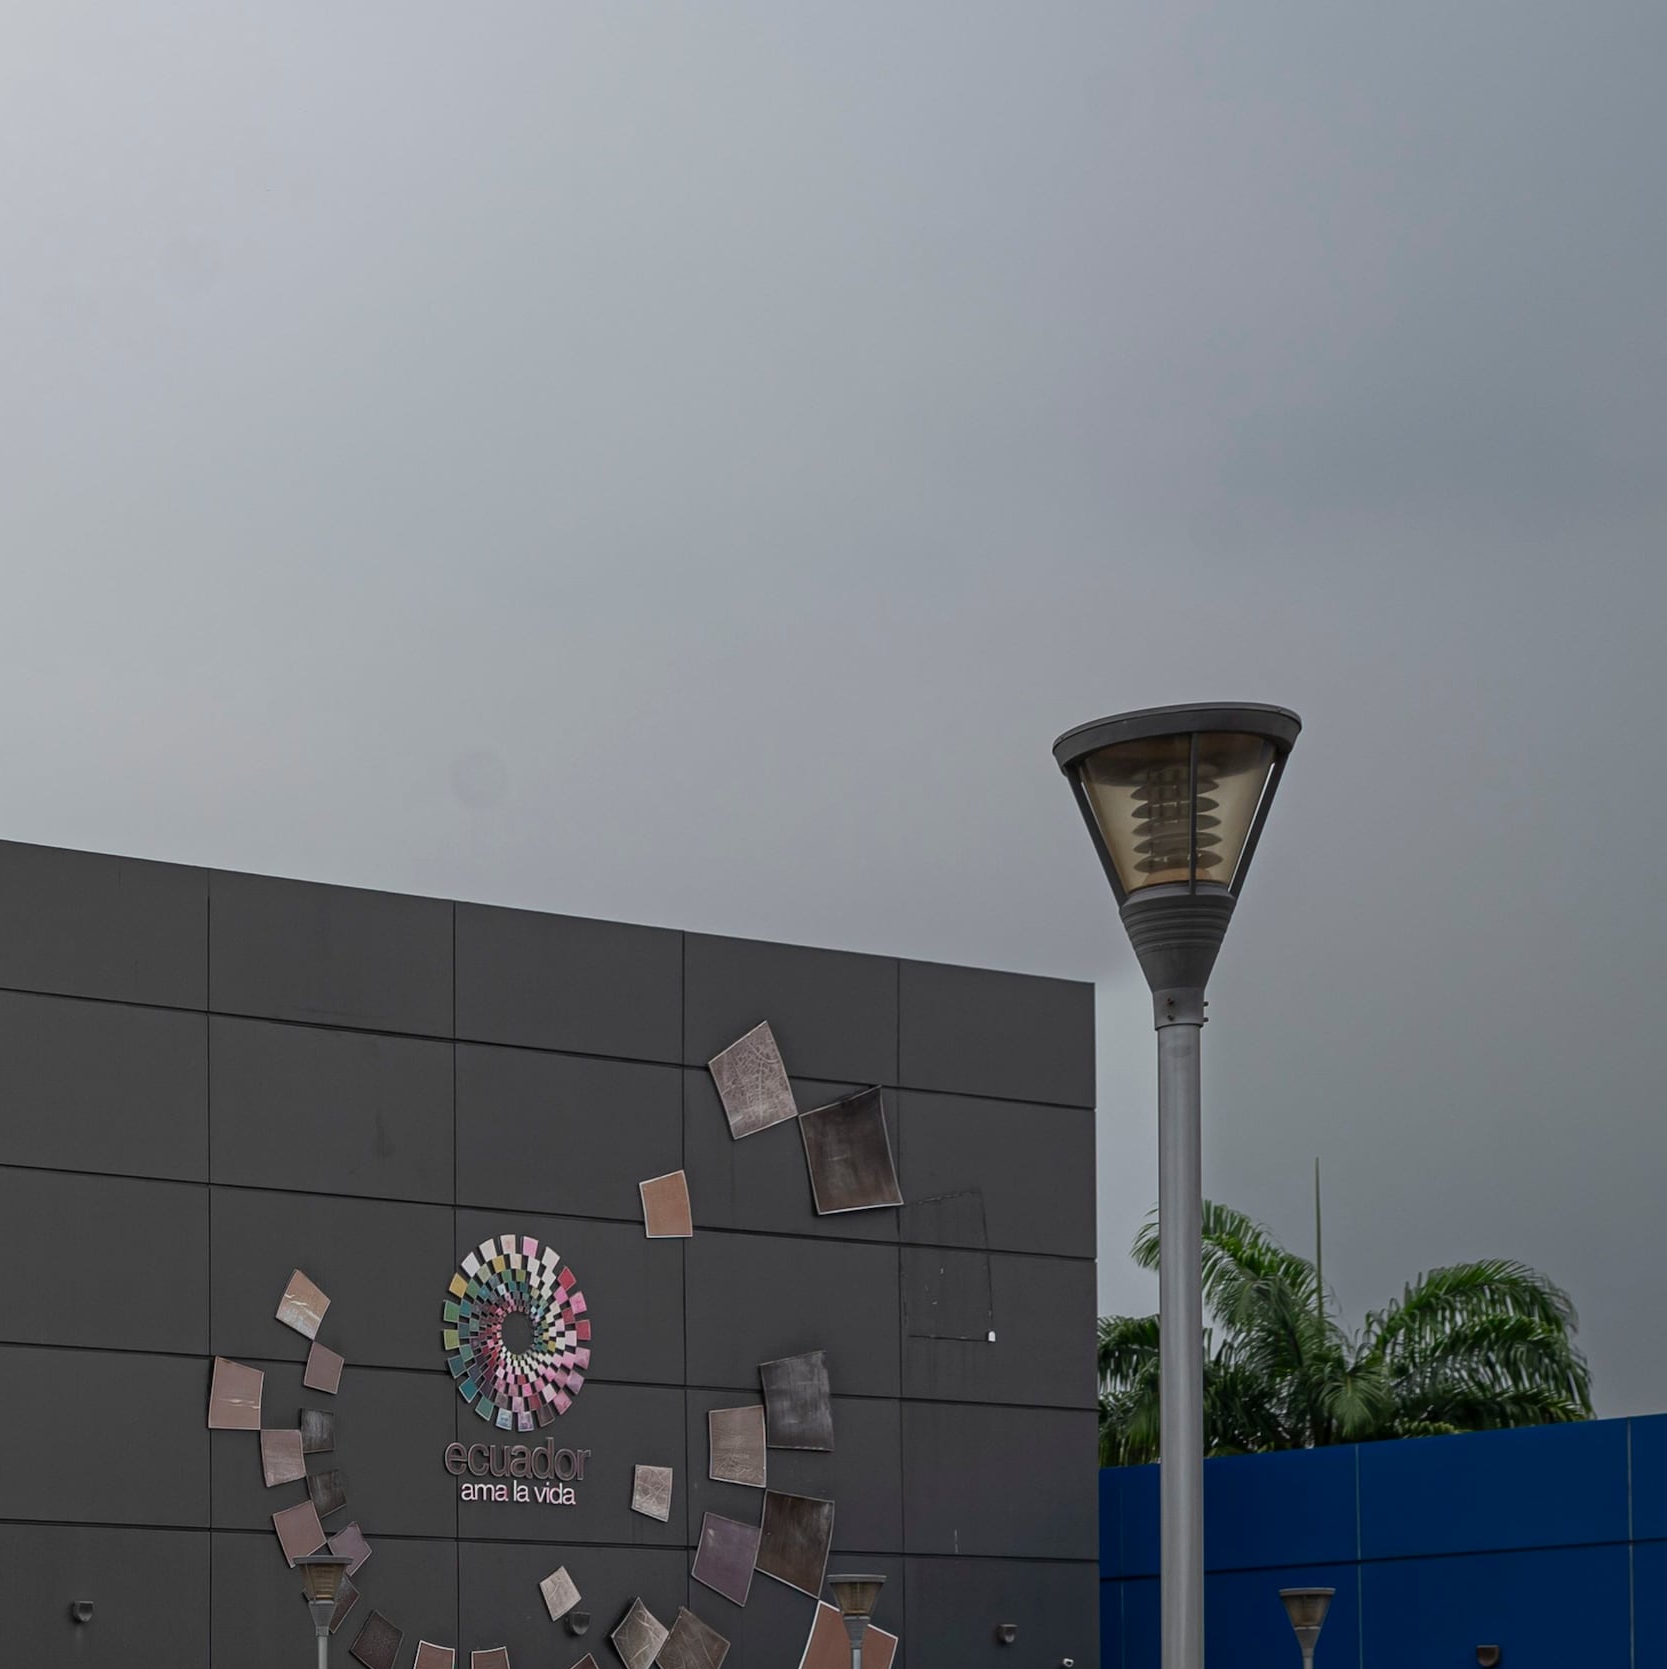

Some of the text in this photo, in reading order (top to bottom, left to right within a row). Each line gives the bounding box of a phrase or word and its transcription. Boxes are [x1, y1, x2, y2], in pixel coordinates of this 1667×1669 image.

[443, 1436, 592, 1482] ecuador
[460, 1479, 576, 1505] ama la vida
